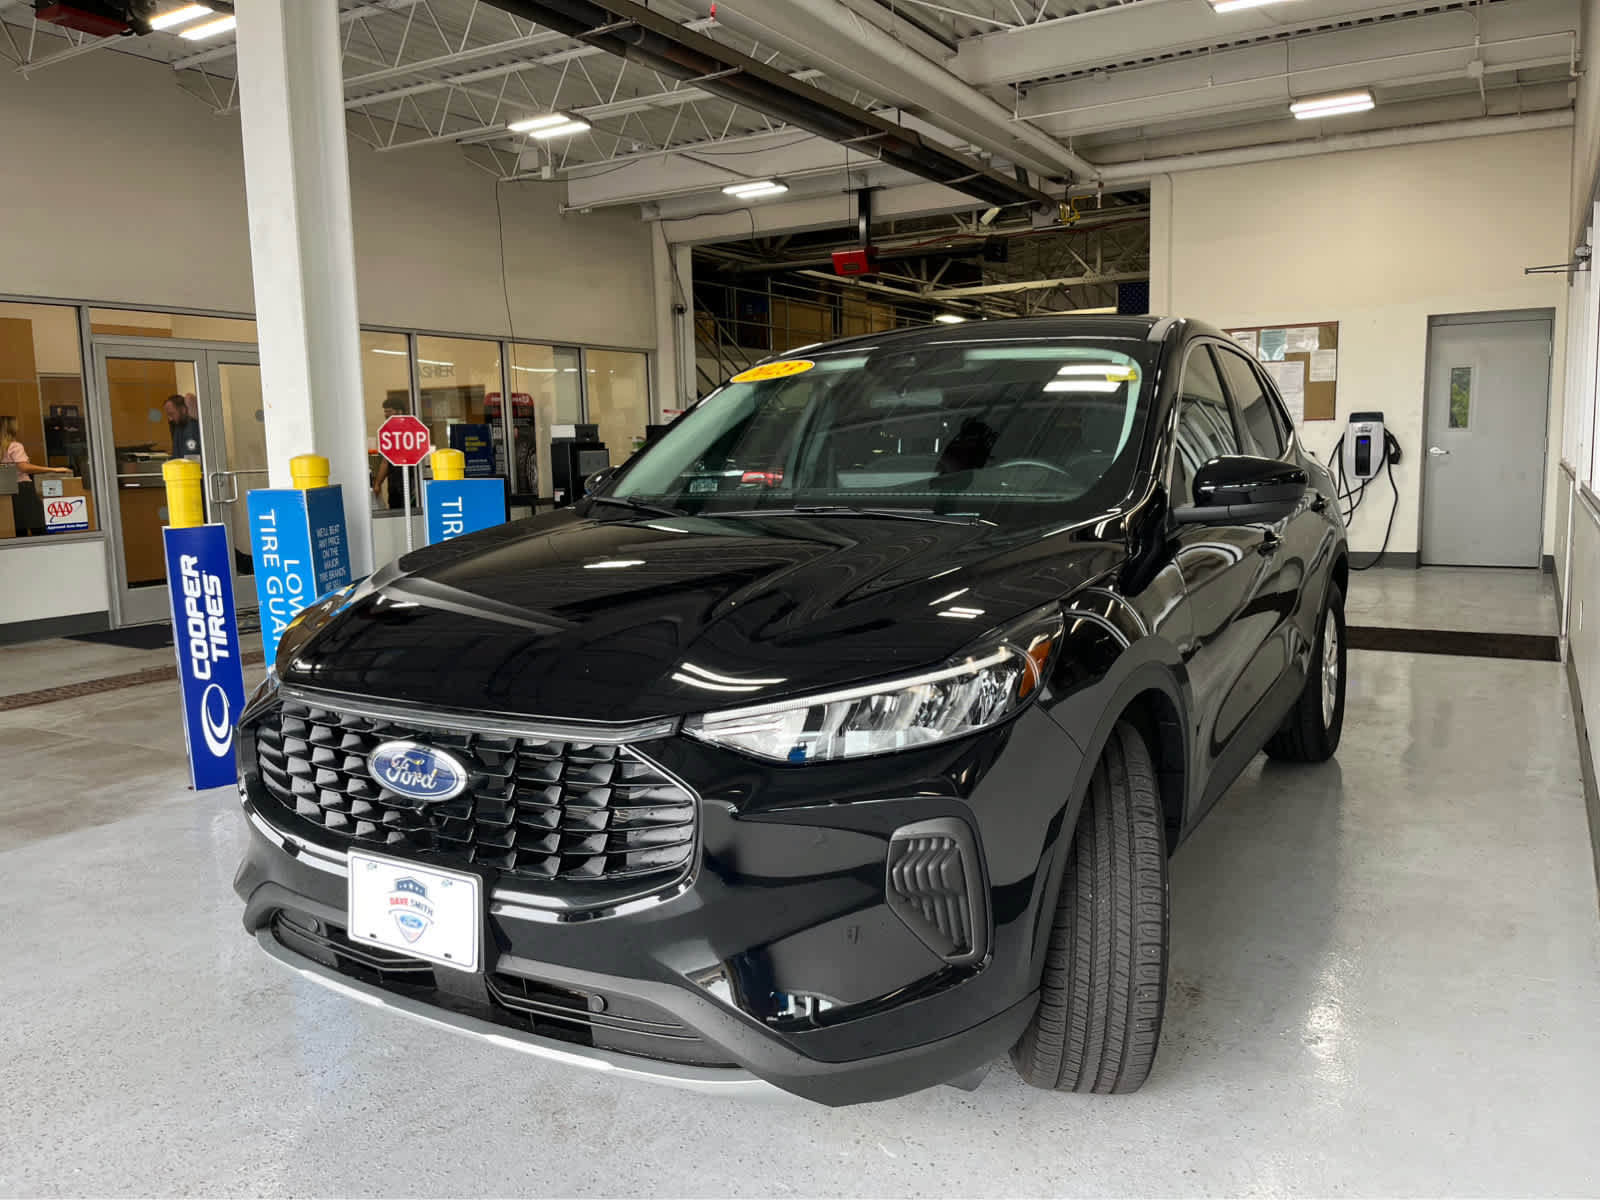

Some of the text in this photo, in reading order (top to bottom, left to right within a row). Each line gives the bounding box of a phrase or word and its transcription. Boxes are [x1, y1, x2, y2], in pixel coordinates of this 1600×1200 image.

[381, 431, 427, 450] STOP
[48, 501, 73, 518] AAA
[441, 496, 464, 541] TIR
[259, 508, 280, 568] TIRE
[328, 536, 340, 545] PRICE
[323, 547, 339, 559] ON THE
[324, 558, 339, 569] MAJOR
[329, 568, 346, 578] BRANDS
[180, 554, 211, 680] COOPER
[203, 574, 230, 663] TIRES
[386, 754, 438, 789] Ford
[390, 896, 433, 917] DAVE SMITH
